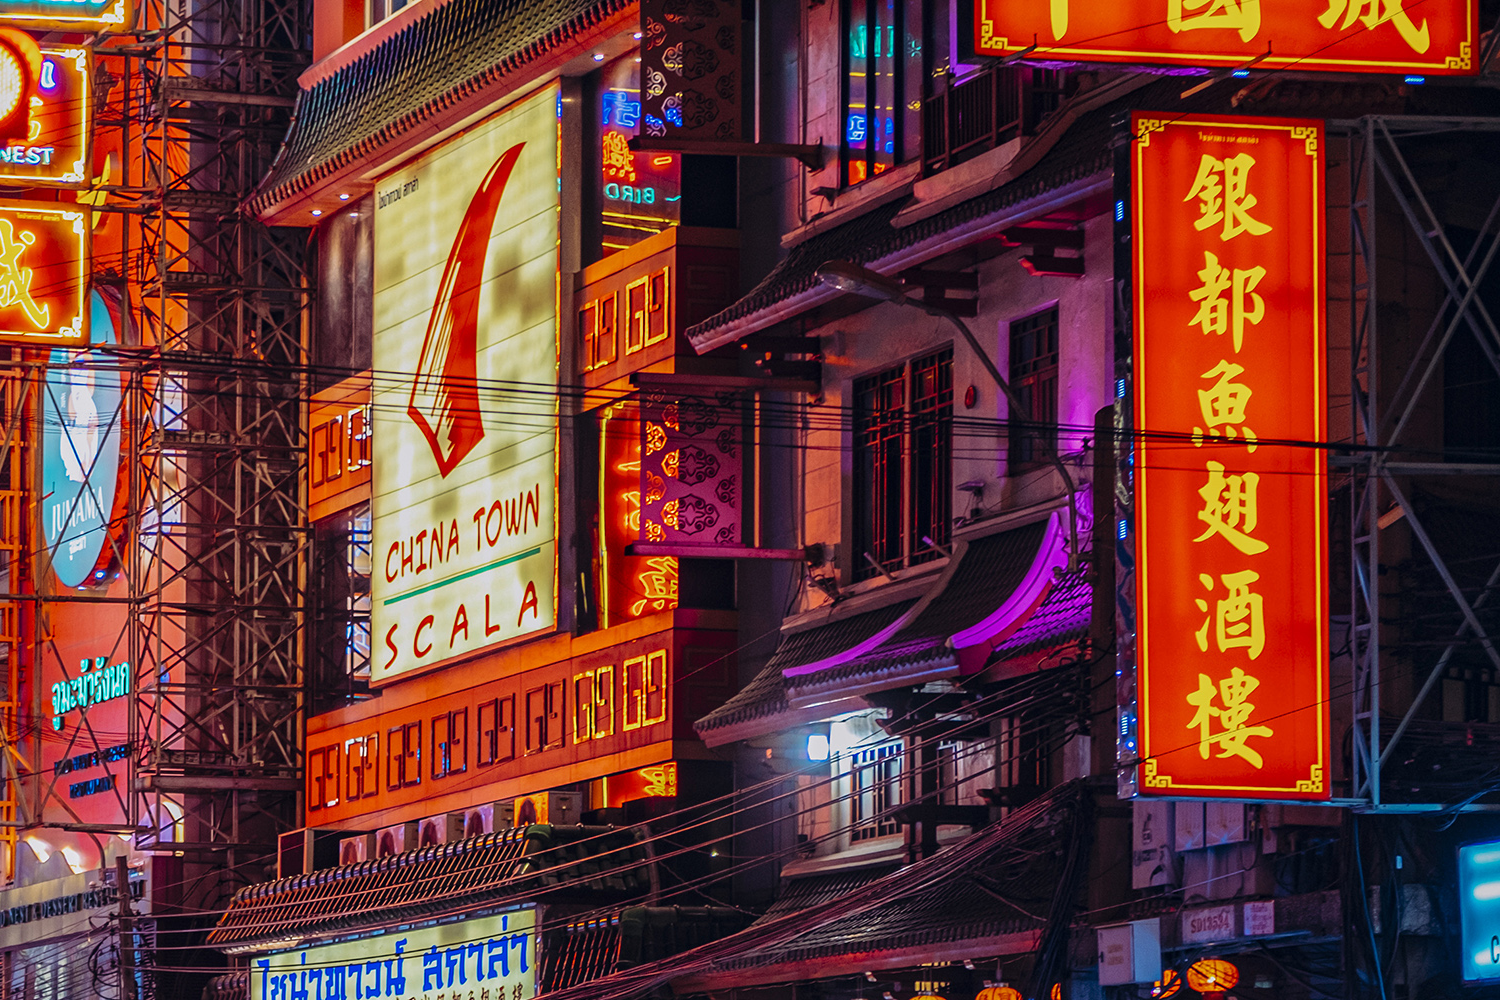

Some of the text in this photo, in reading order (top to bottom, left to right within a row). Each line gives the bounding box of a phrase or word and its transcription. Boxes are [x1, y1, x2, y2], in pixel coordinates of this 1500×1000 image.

[1181, 152, 1273, 769] 銀都魚翅酒樓
[51, 486, 105, 540] JUMAMA
[385, 483, 539, 584] CHINA TOWN
[384, 581, 538, 670] SCALA
[9, 905, 30, 926] NEST
[41, 894, 79, 919] DESSERT
[422, 915, 530, 991] สกาล่า
